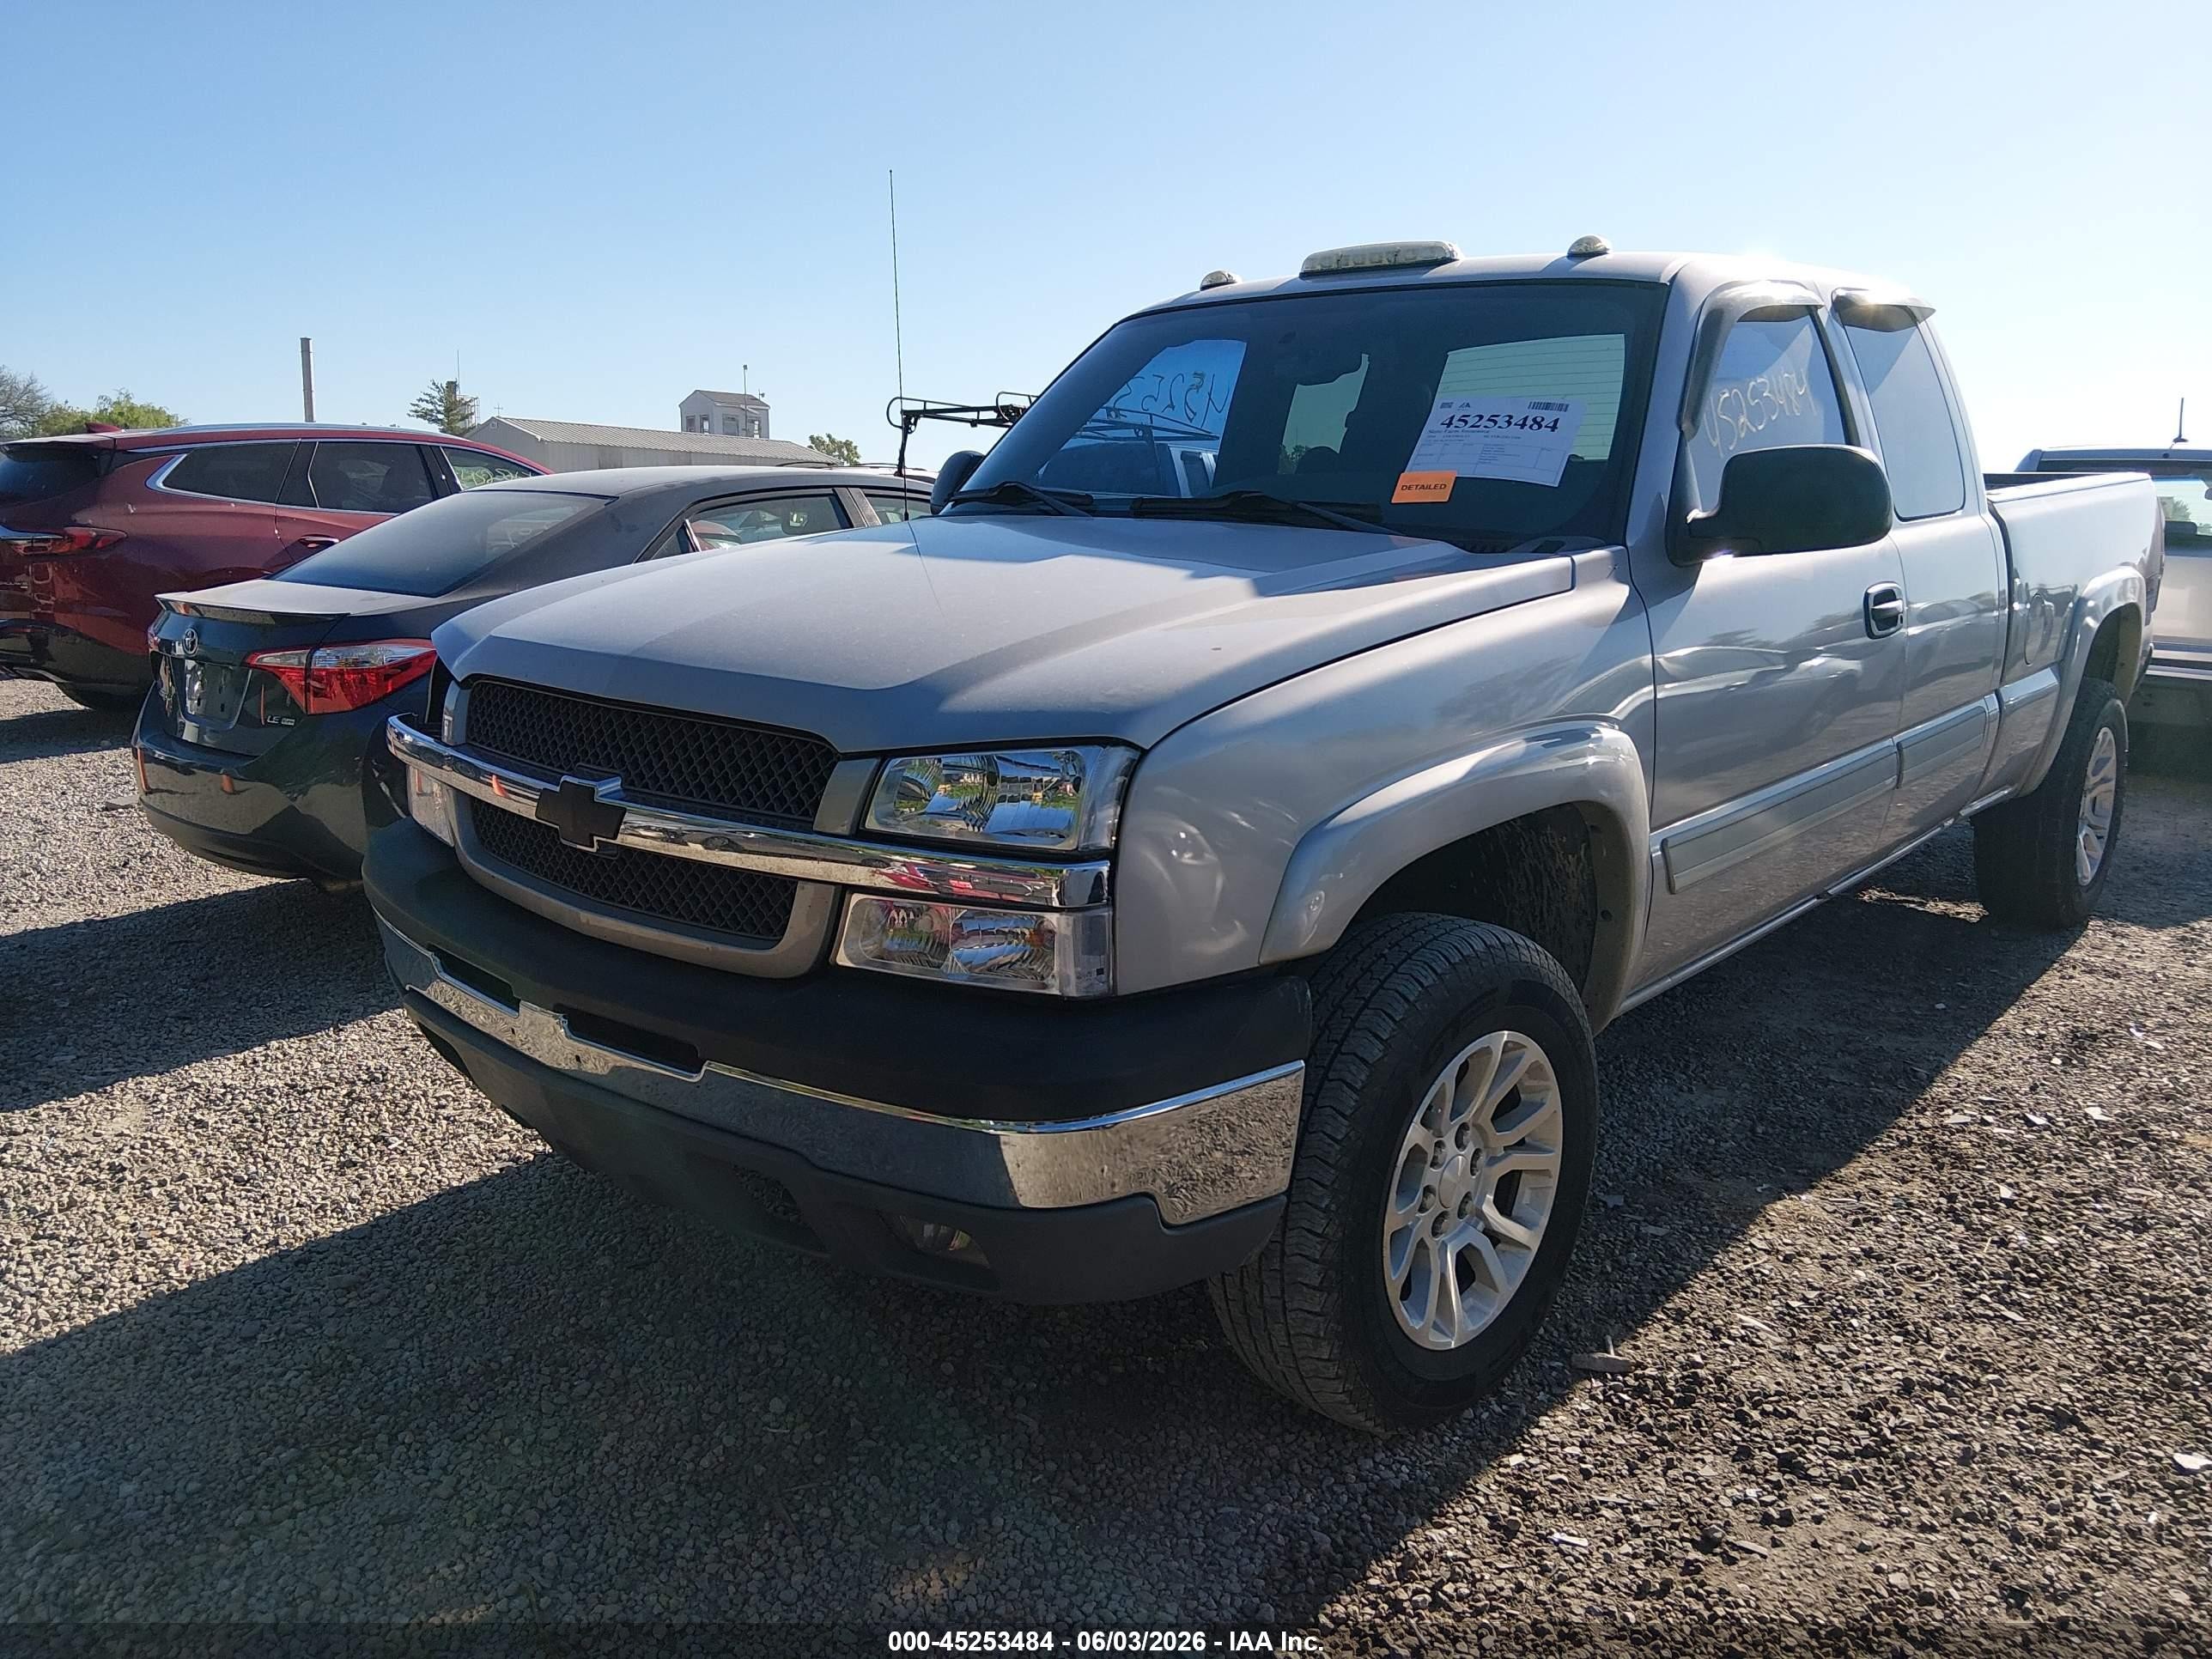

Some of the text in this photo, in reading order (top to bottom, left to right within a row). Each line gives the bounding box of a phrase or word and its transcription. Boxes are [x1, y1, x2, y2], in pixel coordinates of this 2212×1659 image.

[1703, 367, 1817, 459] 45253484
[1440, 414, 1560, 433] 45253484
[1401, 483, 1447, 491] DETAILED
[266, 715, 280, 724] LE
